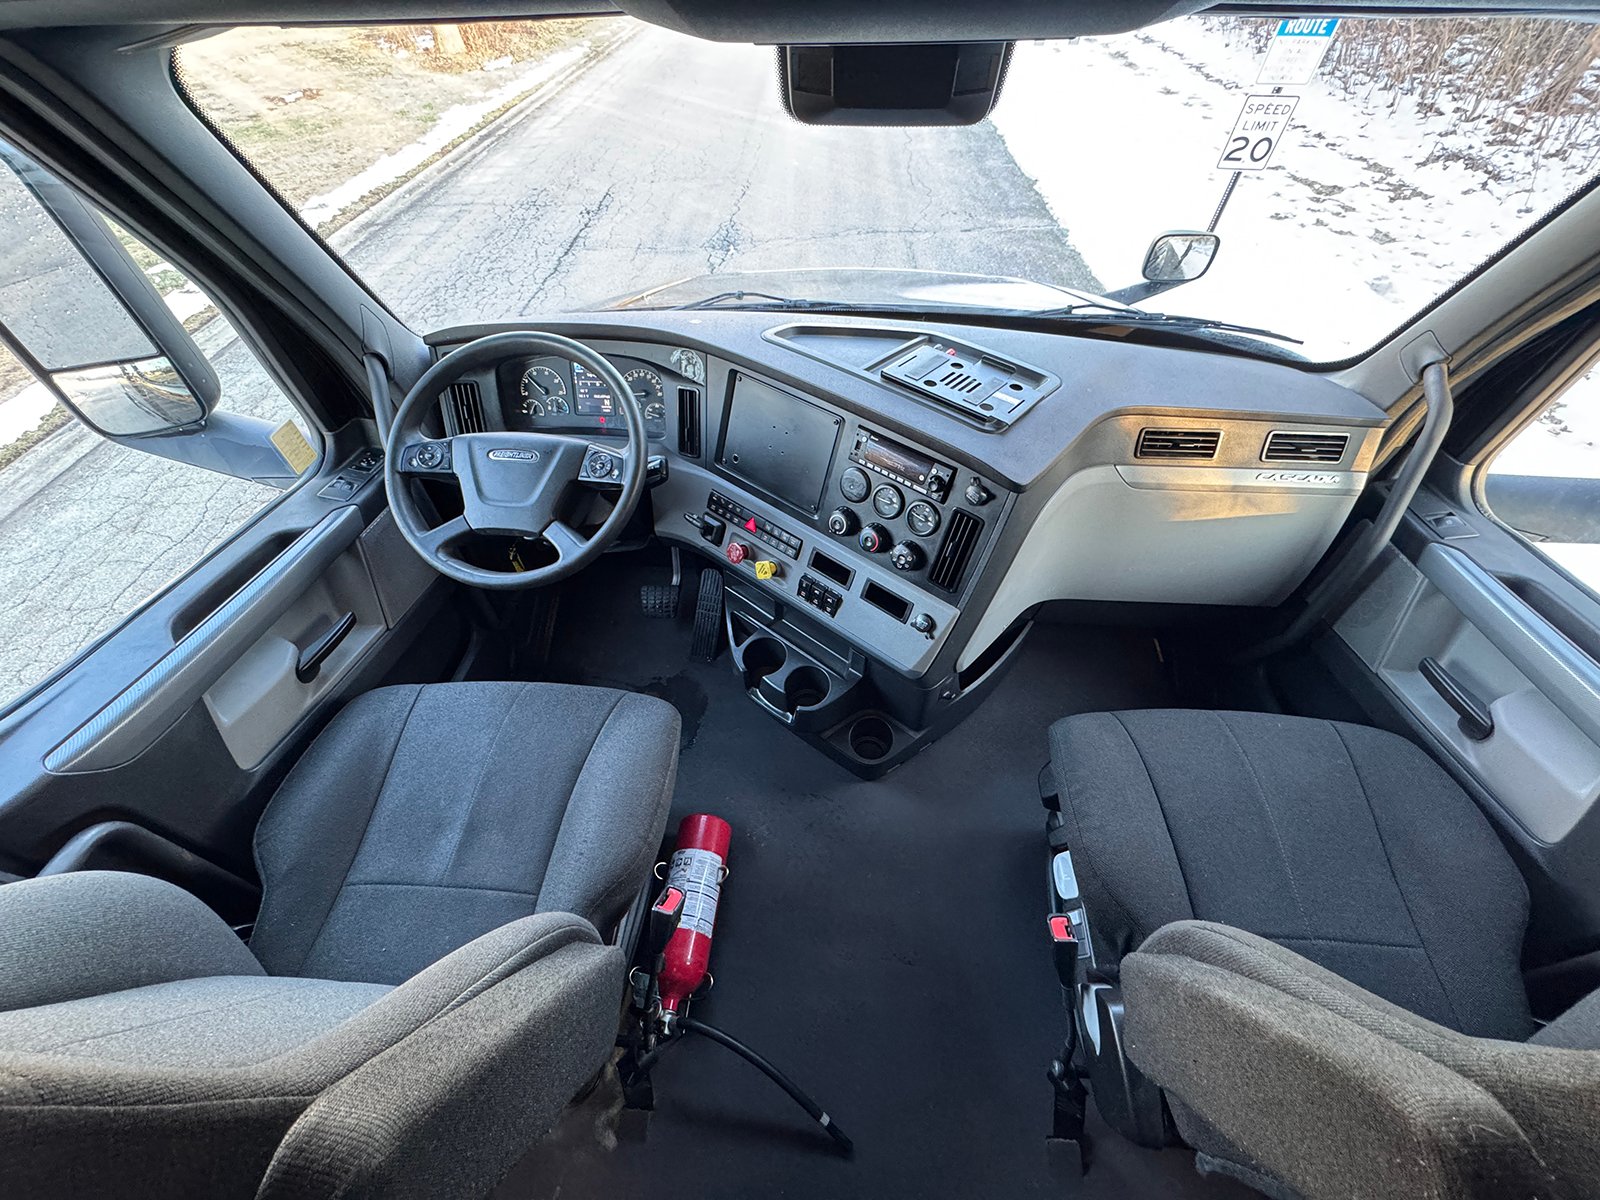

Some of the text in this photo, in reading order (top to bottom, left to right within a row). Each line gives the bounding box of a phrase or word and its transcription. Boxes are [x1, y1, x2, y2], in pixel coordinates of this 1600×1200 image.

[1284, 18, 1331, 34] ROUTE
[1245, 103, 1291, 115] SPEED
[1242, 120, 1279, 132] LIMIT
[1223, 136, 1273, 162] 20
